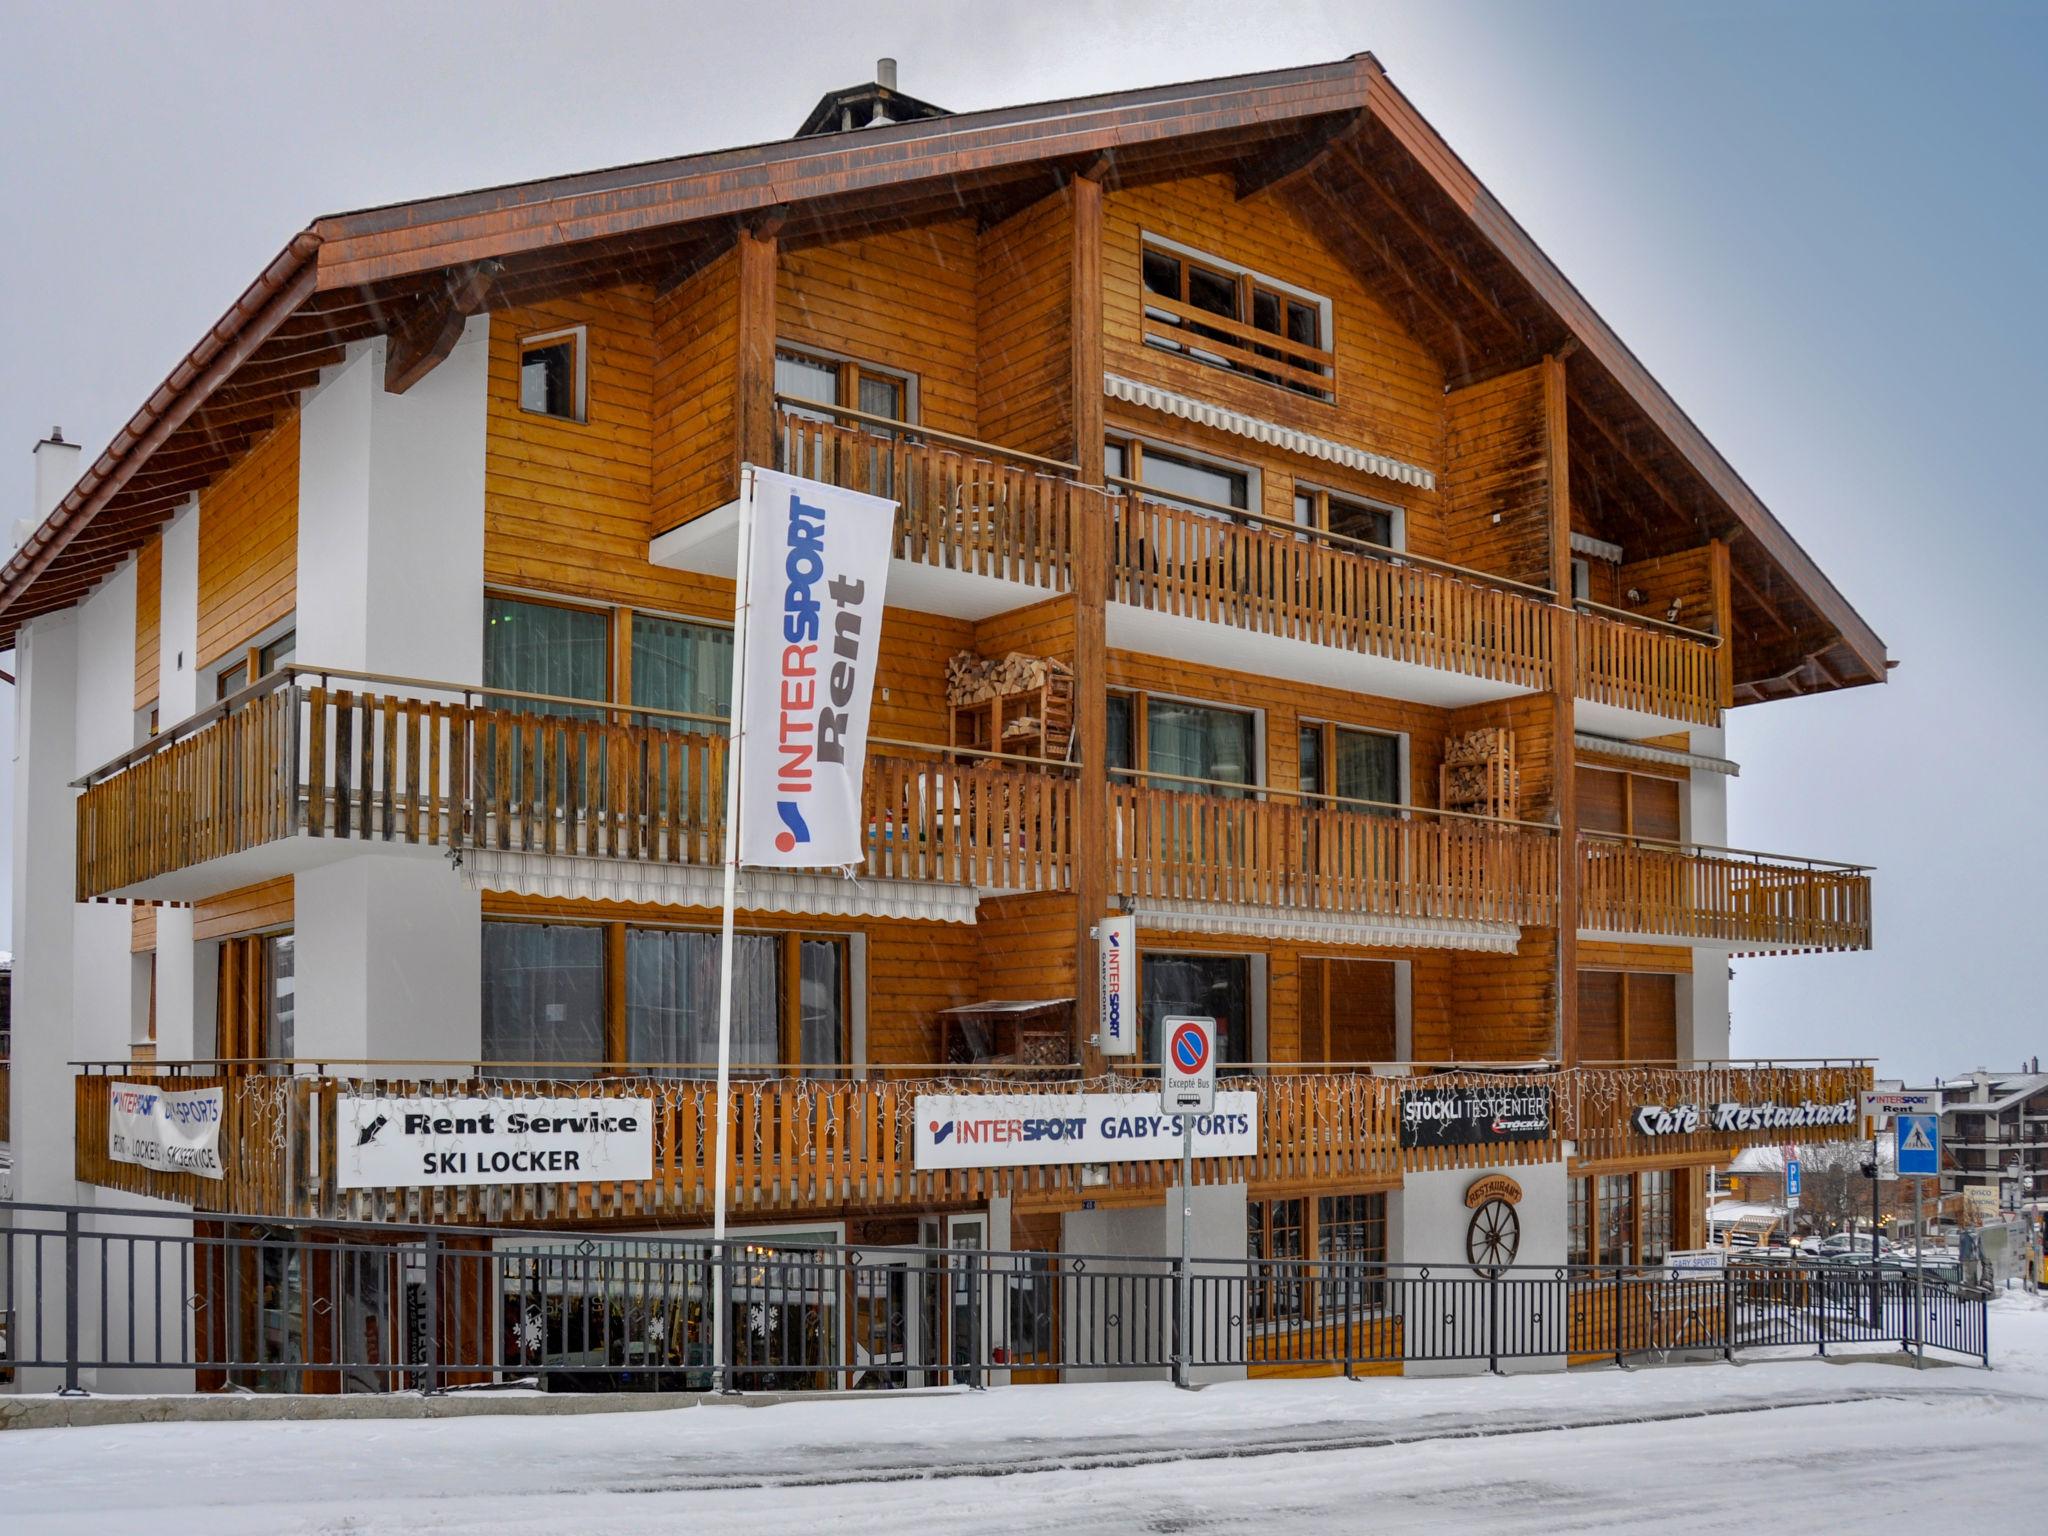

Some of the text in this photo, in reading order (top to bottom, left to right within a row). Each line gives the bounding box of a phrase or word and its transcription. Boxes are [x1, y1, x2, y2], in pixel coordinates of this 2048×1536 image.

[777, 494, 826, 792] INTERSPORT
[816, 574, 865, 766] Rent
[1109, 949, 1120, 1039] INTERSPORT
[1168, 1078, 1210, 1089] Excepté Bus
[1406, 1097, 1545, 1120] STÖCKLI TESTCENTER
[1876, 1095, 1929, 1104] INTERSPORT
[405, 1111, 638, 1135] Rent Service
[1634, 1098, 1857, 1136] Café Restaurant
[956, 1118, 1087, 1144] INTERSPORT
[423, 1150, 580, 1174] SKI LOCKER
[1790, 1164, 1797, 1180] P
[1469, 1181, 1521, 1204] RESTAURANT
